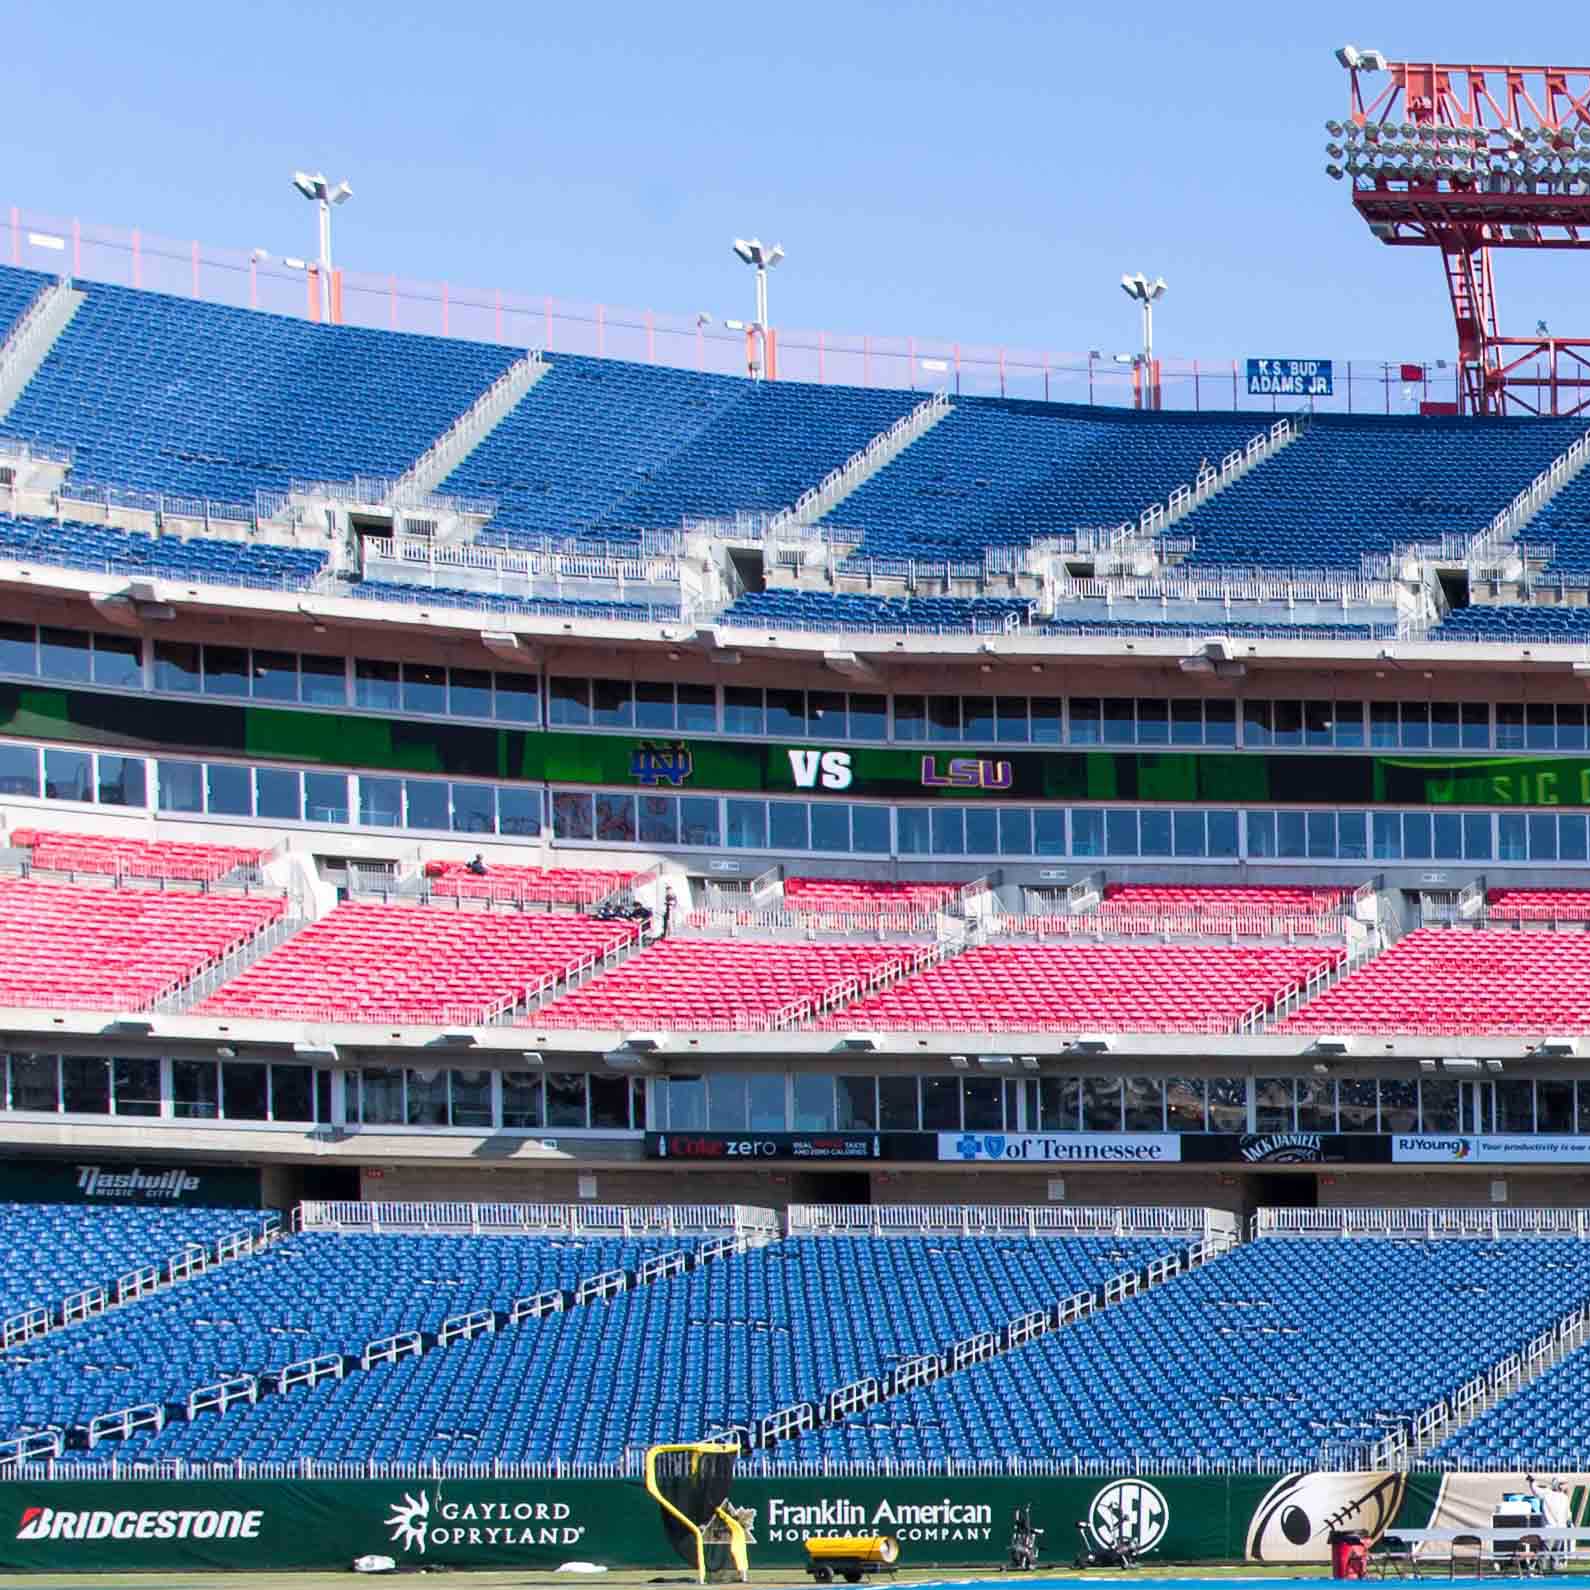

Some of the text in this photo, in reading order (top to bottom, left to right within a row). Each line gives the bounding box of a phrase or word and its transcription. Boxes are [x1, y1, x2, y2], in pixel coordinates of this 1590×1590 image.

[1251, 376, 1331, 394] ADAMS JR.
[787, 749, 853, 789] VS
[920, 754, 1013, 789] LSU
[671, 1135, 777, 1157] Coke zero
[1006, 1136, 1161, 1160] of Tennessee
[1241, 1137, 1273, 1162] JACK
[1400, 1138, 1460, 1155] RJYoung
[76, 1166, 200, 1198] Nashville
[16, 1508, 265, 1539] BRIDGESTONE
[441, 1504, 570, 1520] GAYLORD
[768, 1498, 992, 1526] Franklin American
[1096, 1485, 1162, 1546] SEC
[769, 1527, 993, 1542] MORTGAGE COMPANY
